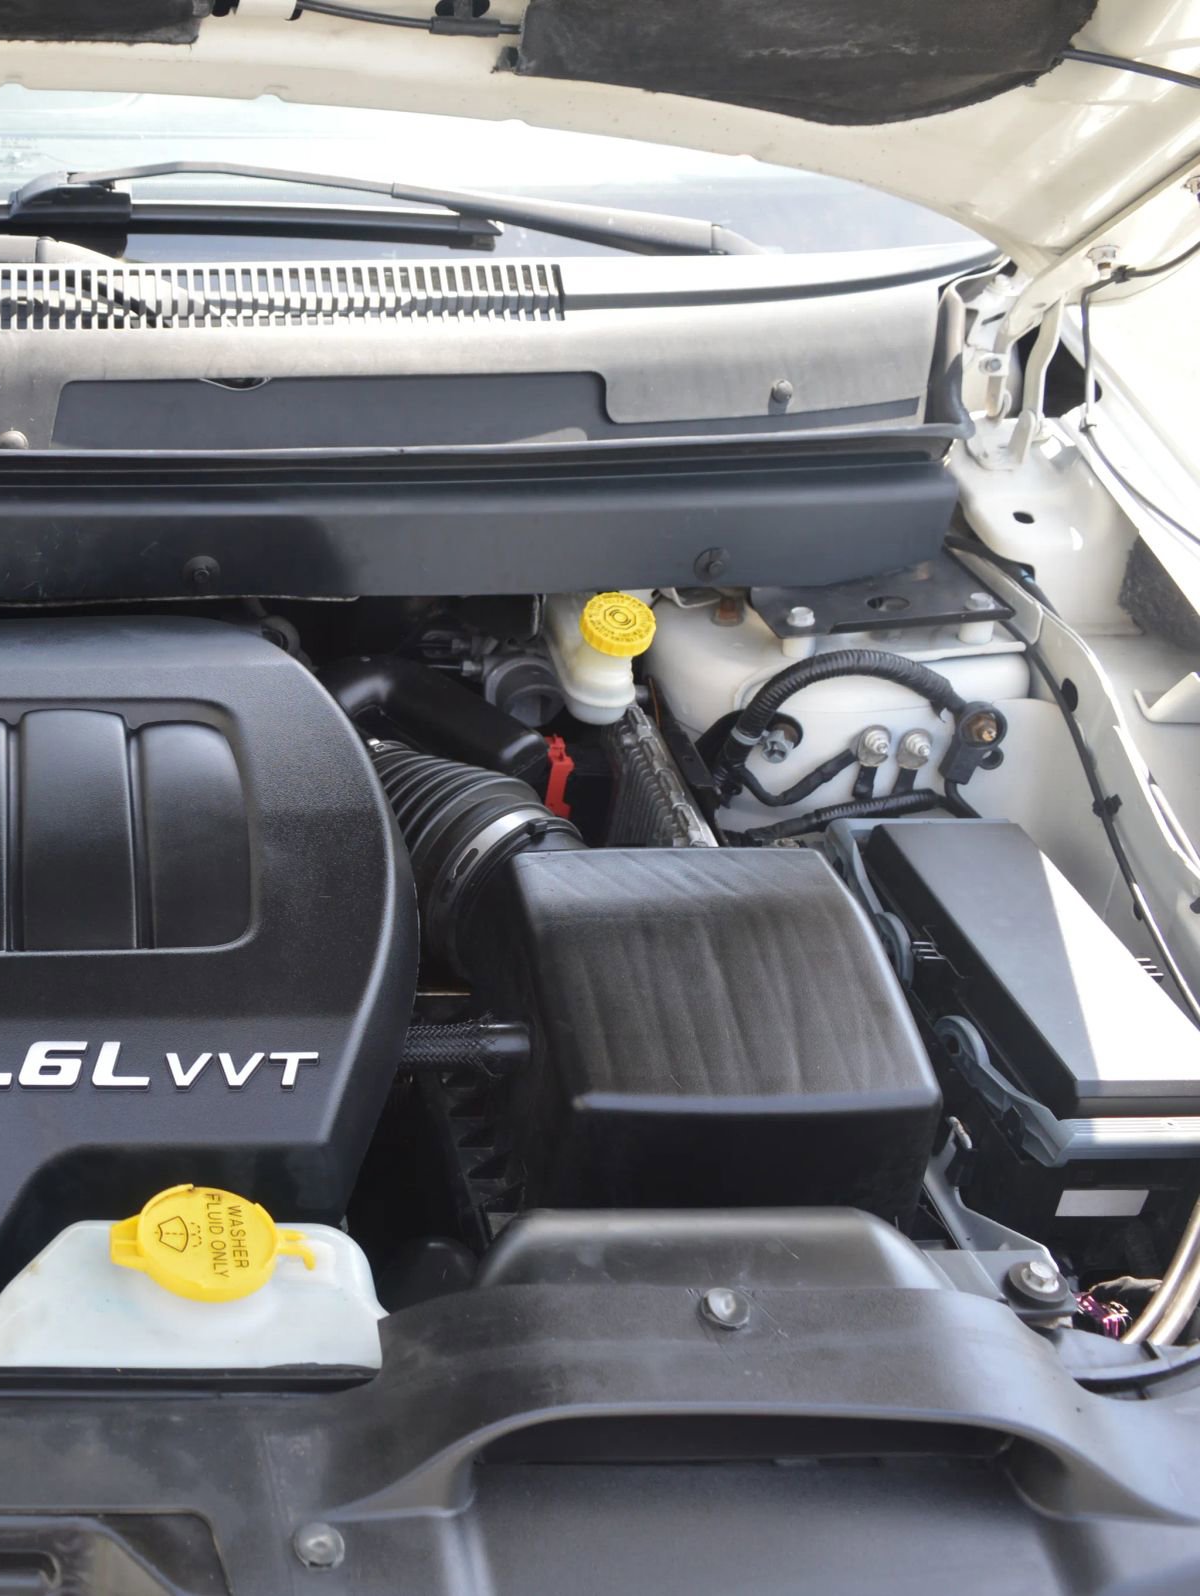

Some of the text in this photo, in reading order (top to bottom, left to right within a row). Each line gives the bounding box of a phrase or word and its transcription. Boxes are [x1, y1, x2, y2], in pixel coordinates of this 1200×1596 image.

[166, 1052, 320, 1091] VVT
[205, 1193, 231, 1278] FLUID ONLY
[227, 1205, 250, 1269] WASHER
